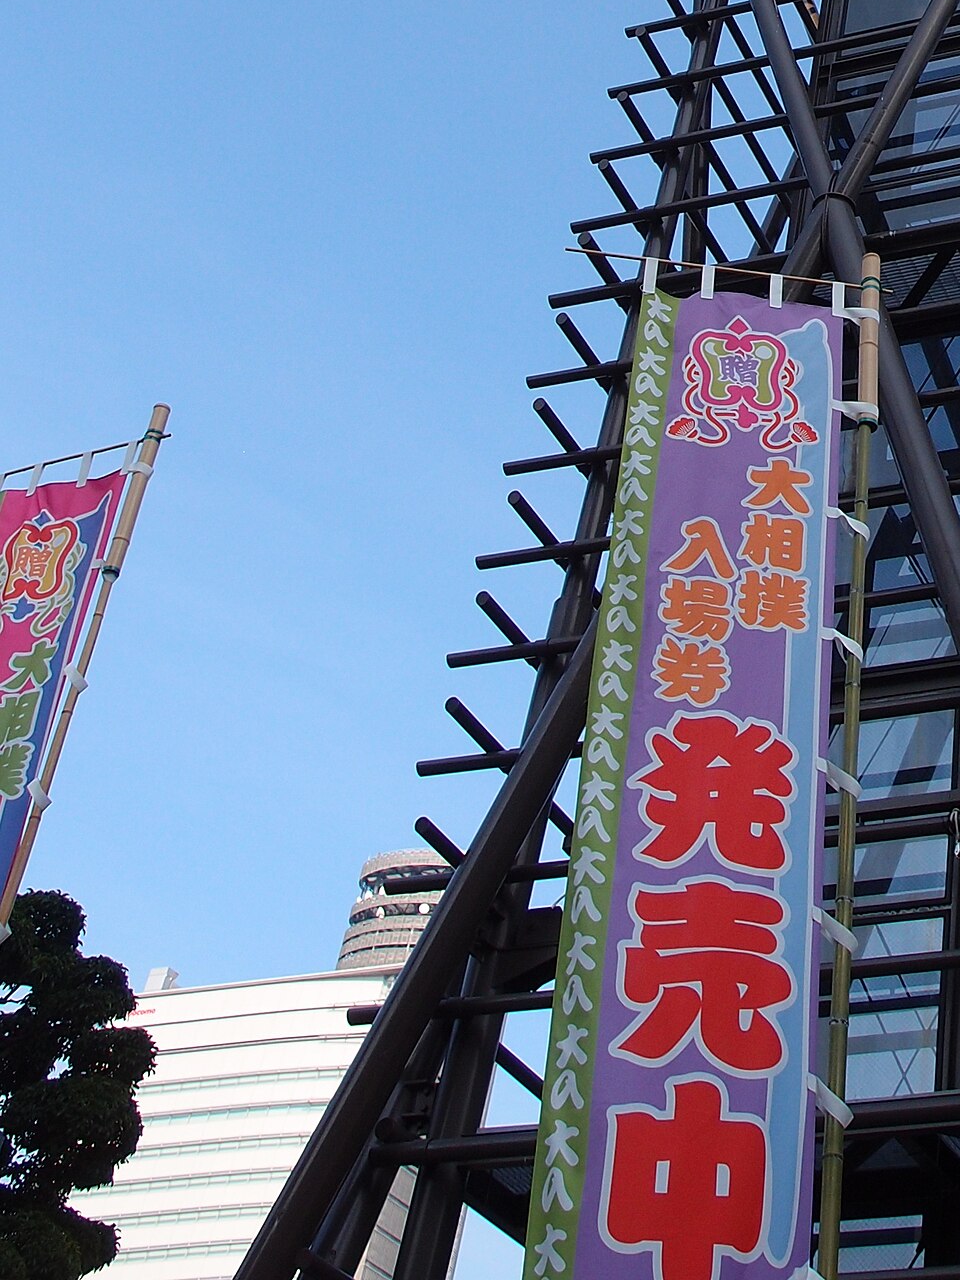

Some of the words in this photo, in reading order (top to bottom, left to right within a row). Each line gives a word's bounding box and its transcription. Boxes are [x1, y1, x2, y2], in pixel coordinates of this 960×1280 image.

[719, 353, 760, 387] 贈
[12, 545, 53, 577] 贈
[656, 518, 735, 705] 入場券
[736, 458, 814, 632] 大相撲
[600, 710, 798, 1280] 発売中
